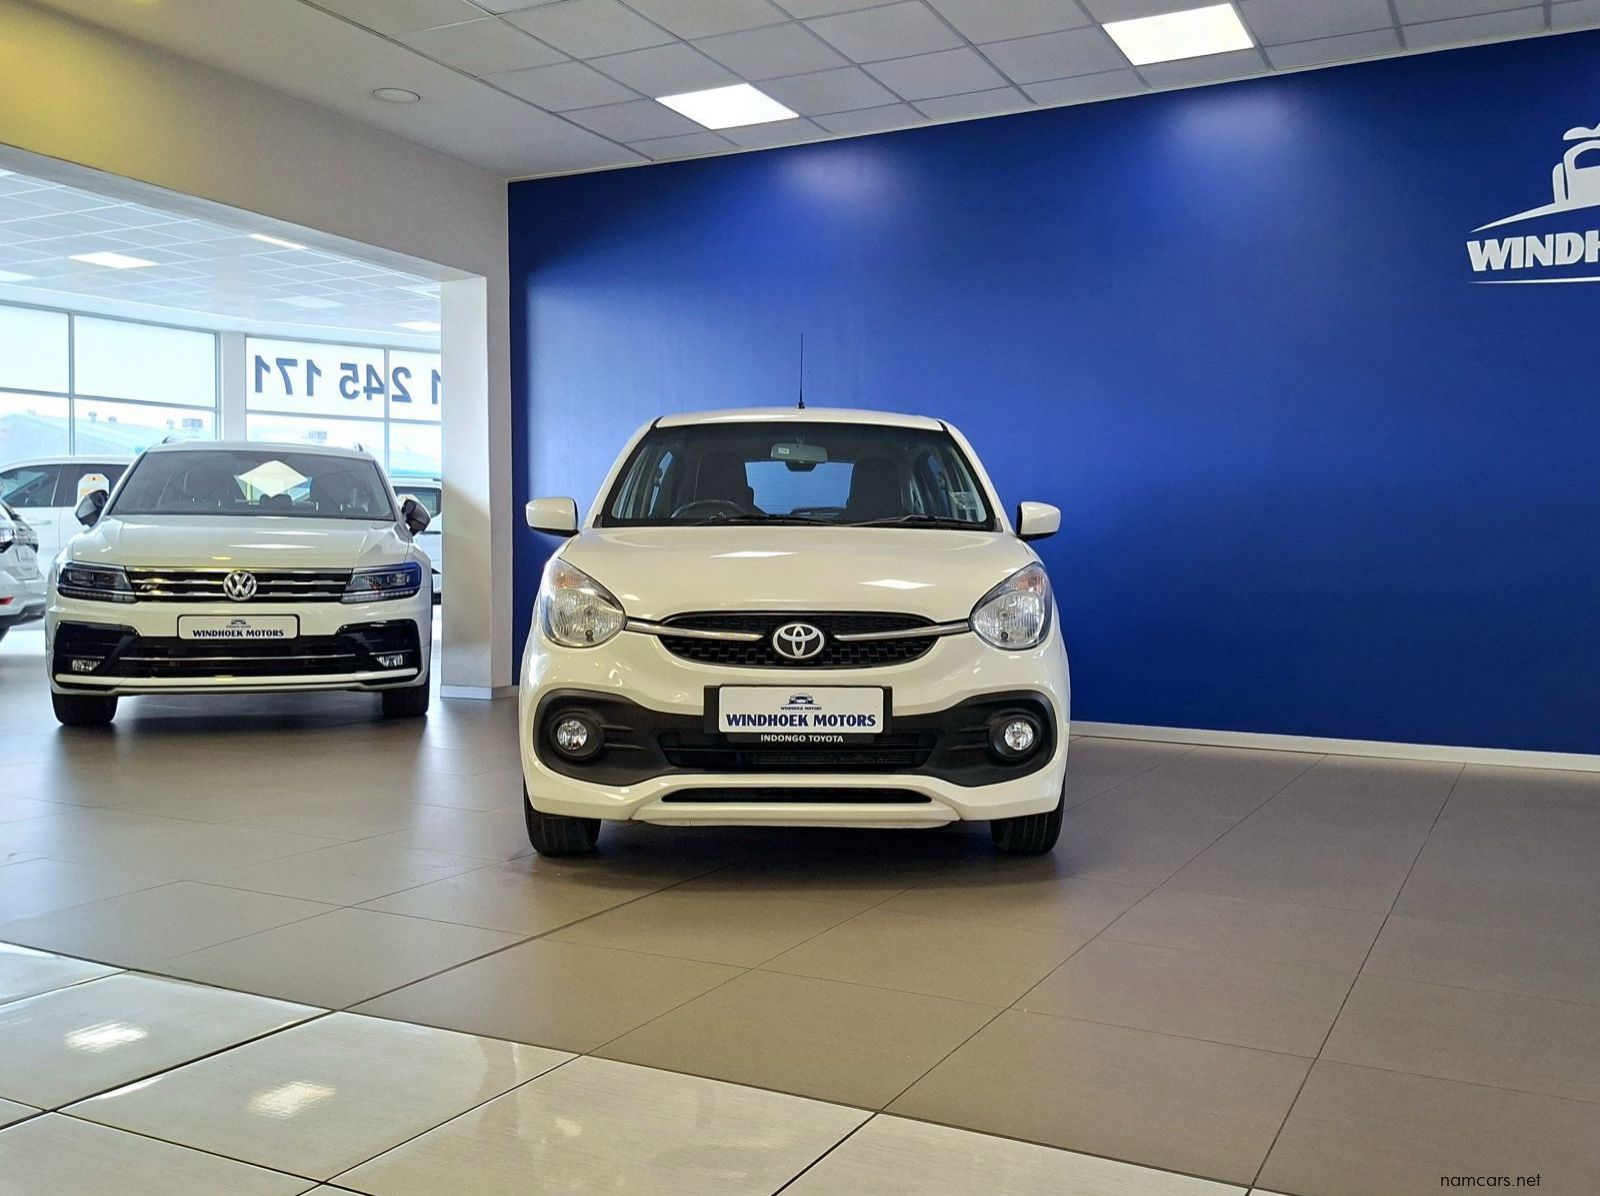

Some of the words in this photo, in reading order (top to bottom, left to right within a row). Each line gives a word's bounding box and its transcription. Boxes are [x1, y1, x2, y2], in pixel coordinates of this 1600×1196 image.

[726, 714, 809, 726] WINDHOEK
[813, 714, 876, 727] MOTORS
[760, 734, 806, 743] INDONGO
[808, 735, 844, 743] TOYOTA
